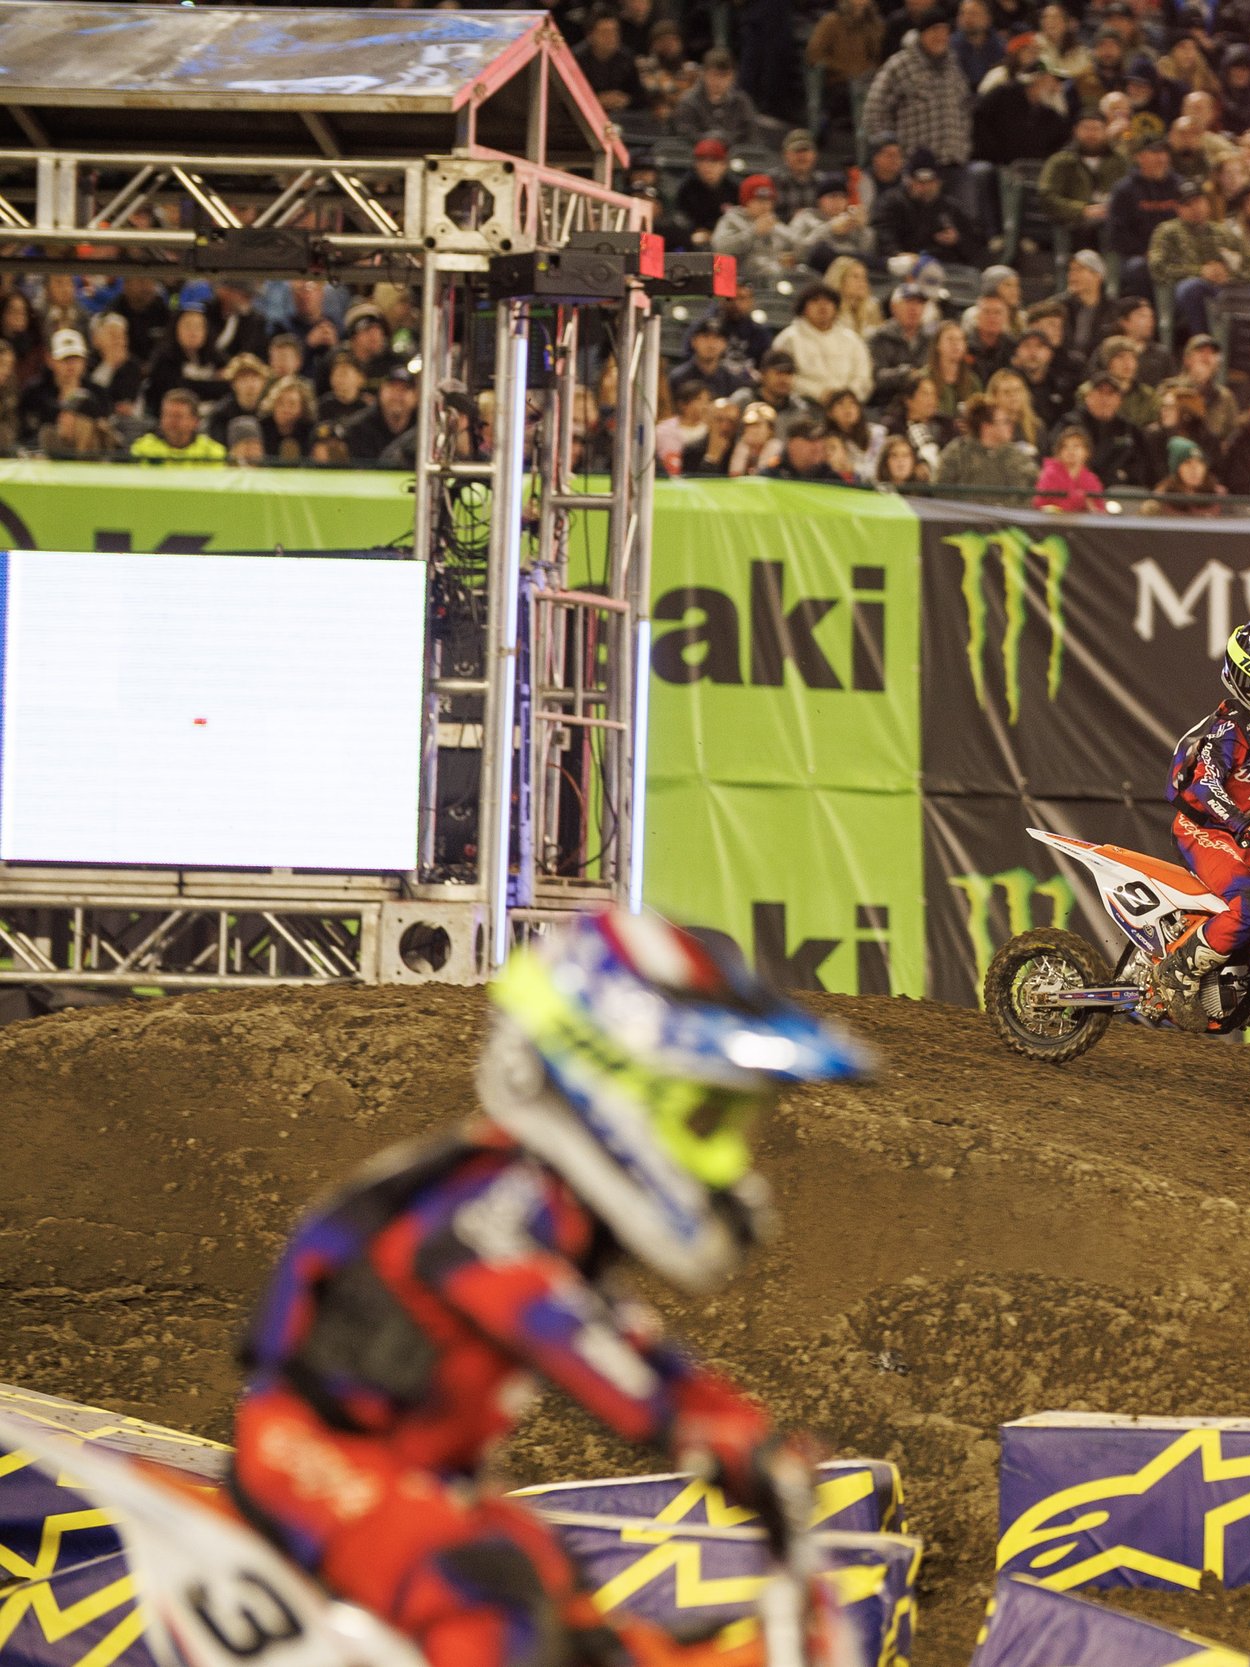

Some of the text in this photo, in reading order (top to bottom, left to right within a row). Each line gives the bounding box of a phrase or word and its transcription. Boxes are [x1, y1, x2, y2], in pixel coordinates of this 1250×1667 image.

[572, 558, 886, 692] aki
[1207, 799, 1230, 820] KTM
[1113, 881, 1160, 917] 9
[184, 1568, 305, 1660] 3
